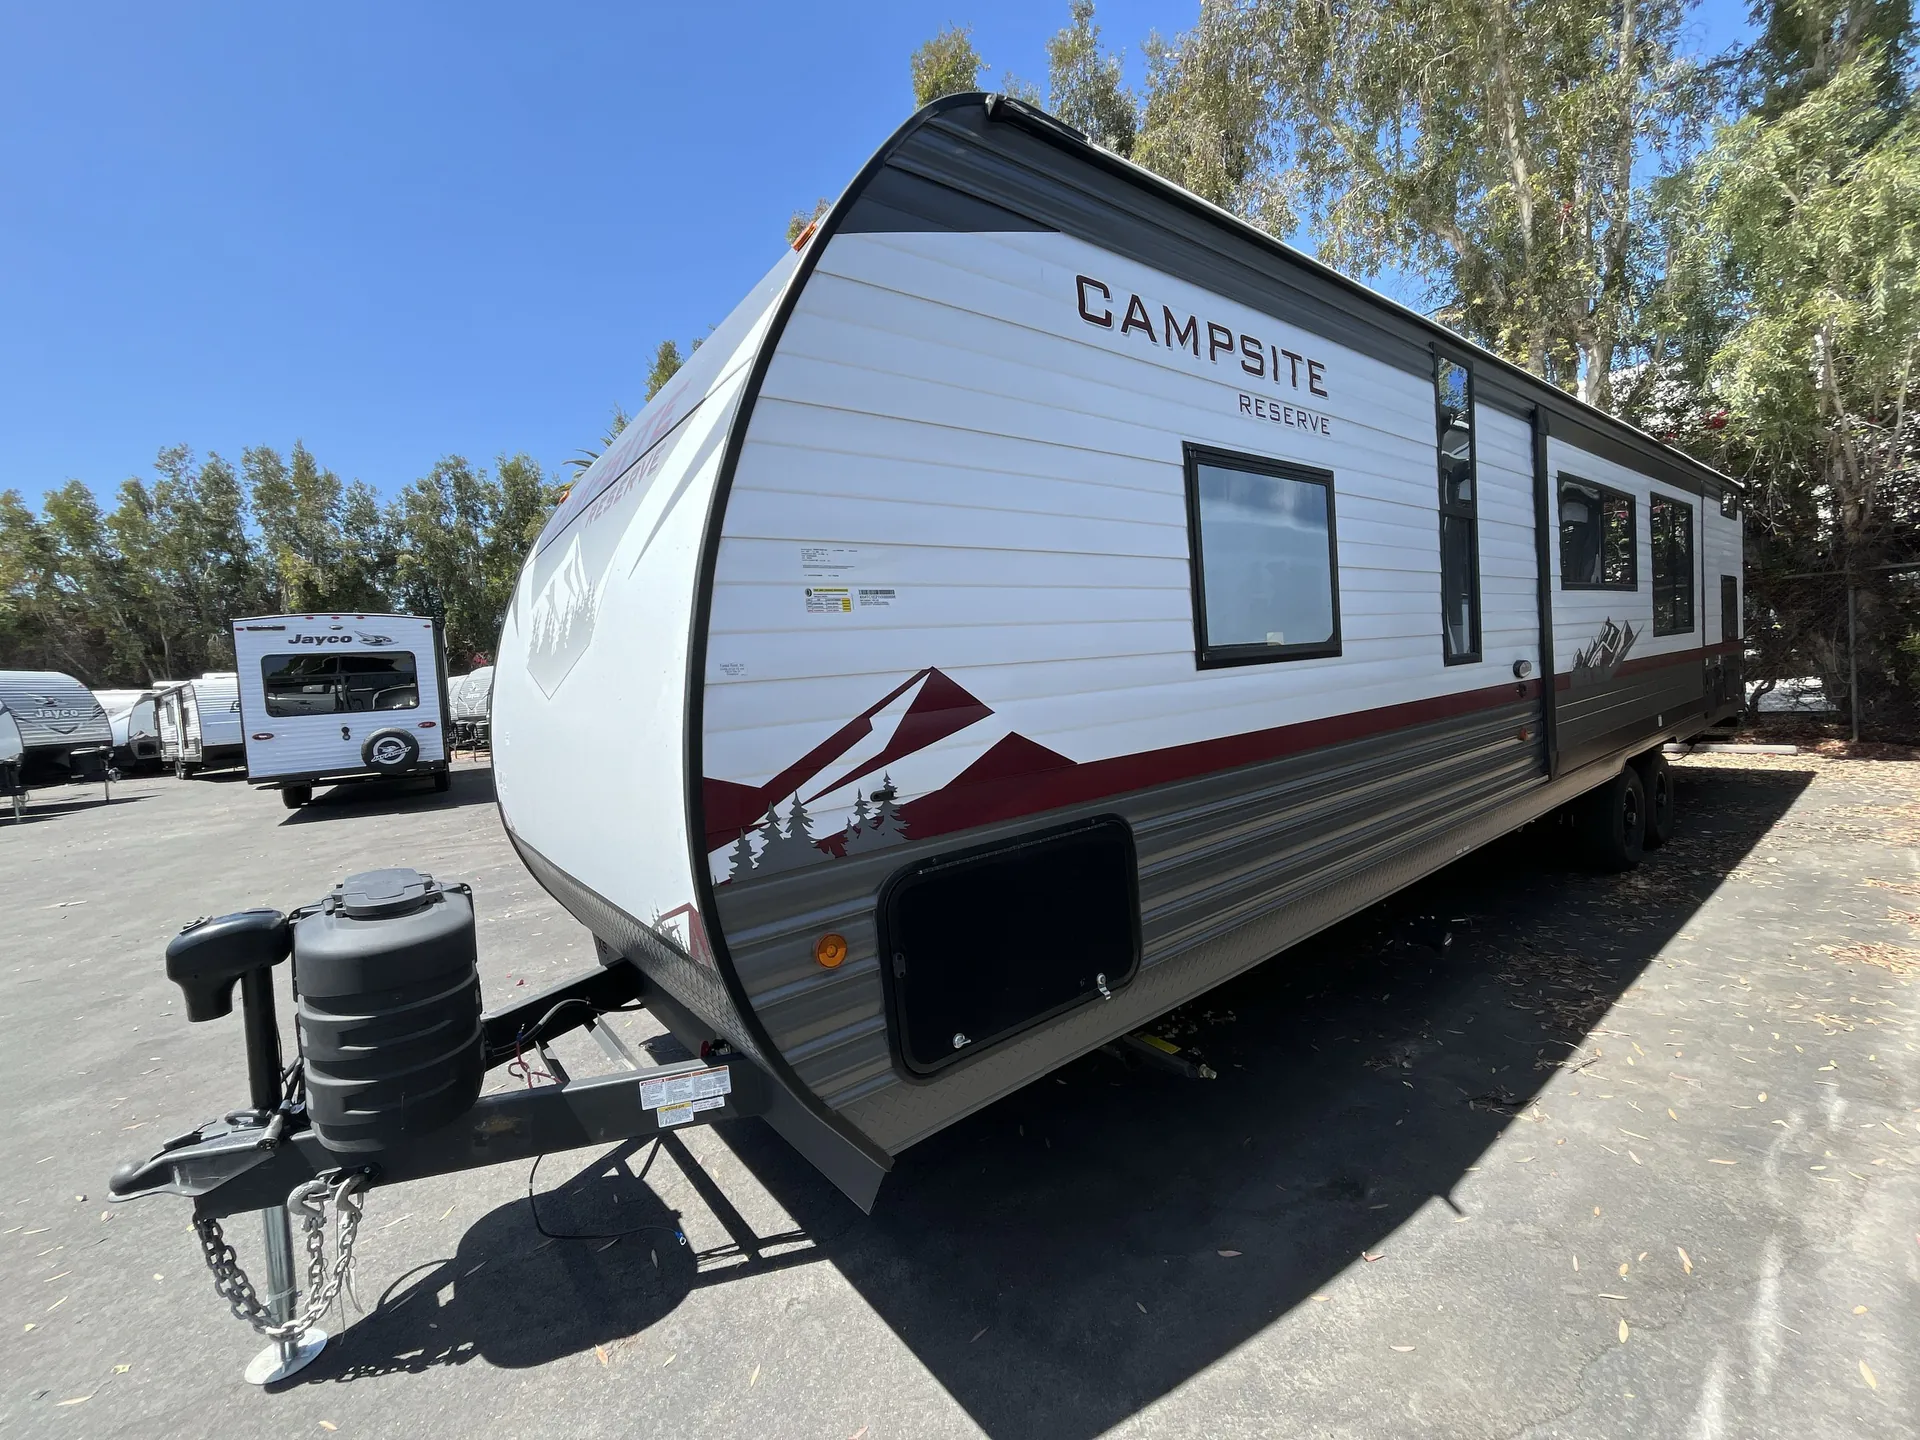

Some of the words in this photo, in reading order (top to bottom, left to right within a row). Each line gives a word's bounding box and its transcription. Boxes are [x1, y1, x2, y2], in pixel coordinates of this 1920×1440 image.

[1075, 273, 1329, 398] CAMPSITE
[1238, 393, 1332, 437] RESERVE
[584, 442, 668, 529] RESERVE
[287, 633, 353, 646] Jayco
[35, 708, 79, 719] Jayco
